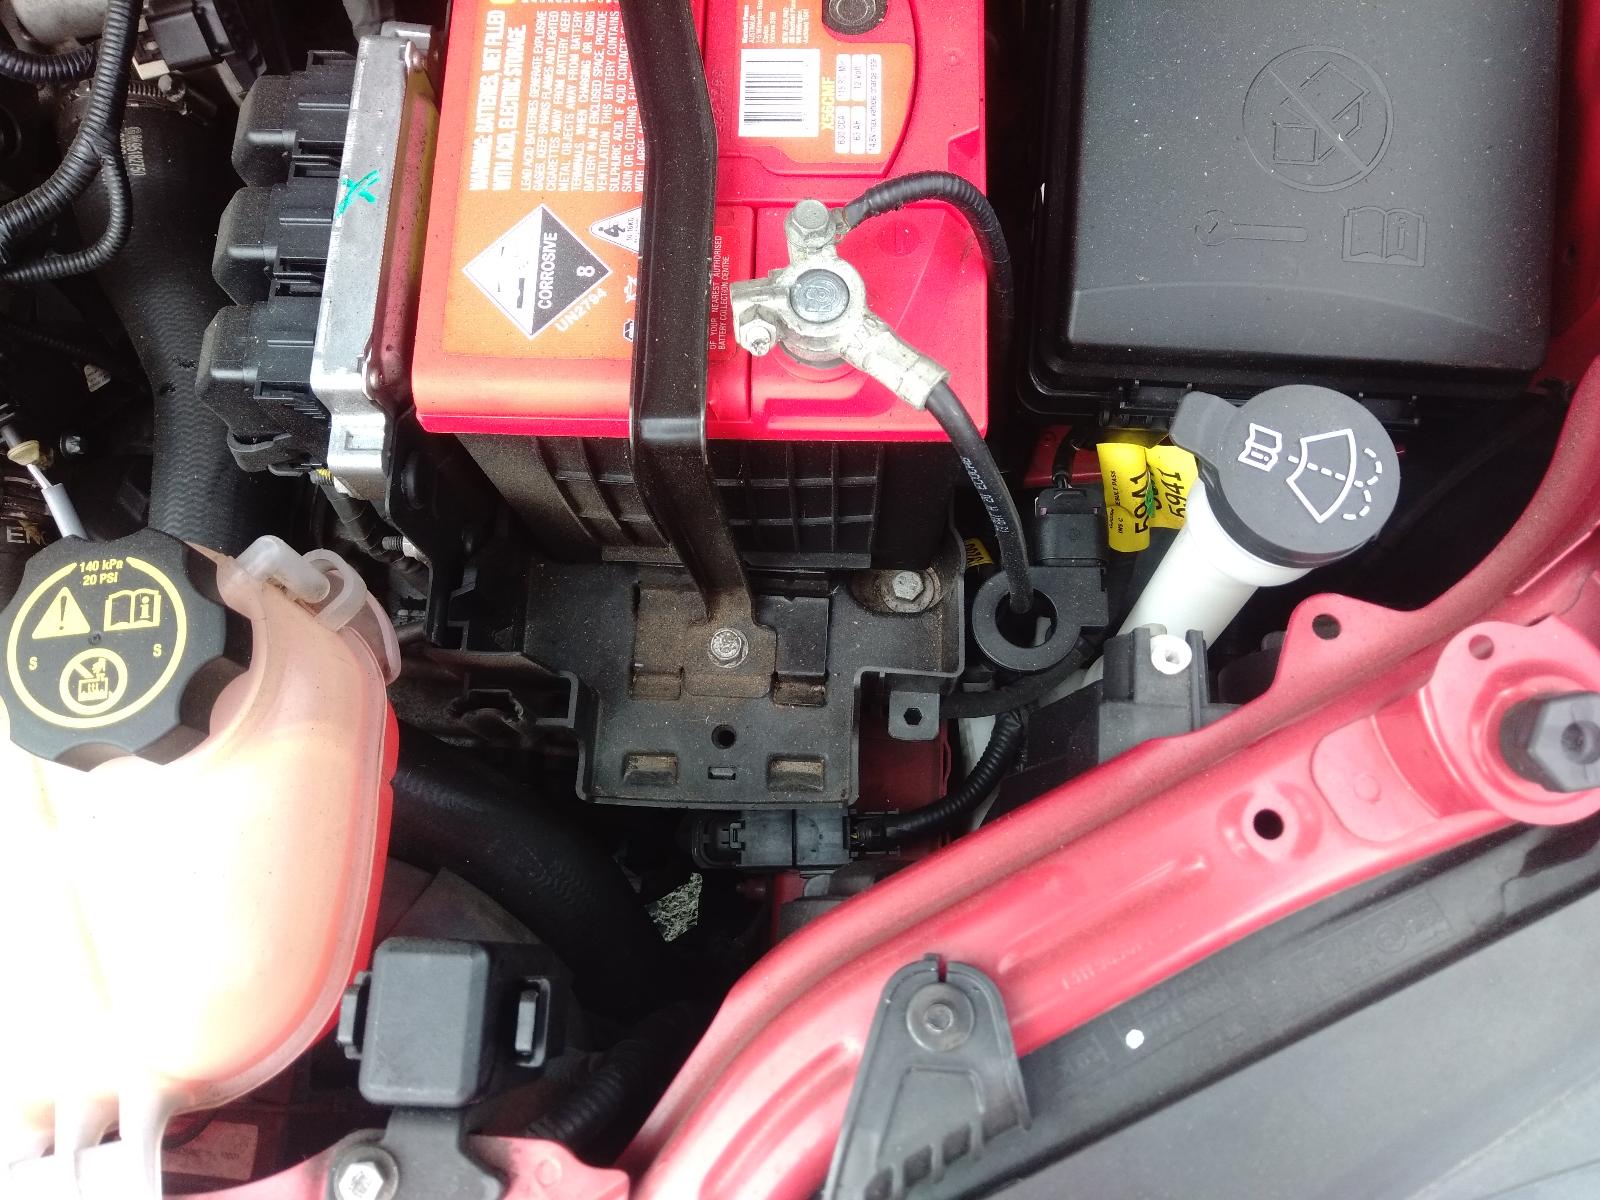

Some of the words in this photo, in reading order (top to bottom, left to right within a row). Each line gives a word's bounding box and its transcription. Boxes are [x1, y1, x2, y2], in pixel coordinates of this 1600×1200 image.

[532, 10, 548, 54] EXPLOSIVE
[546, 10, 560, 46] LIGHTED
[560, 10, 571, 32] KEEP
[570, 10, 583, 49] BATTERY
[583, 11, 596, 35] USING
[596, 11, 608, 46] PROVIDE
[607, 11, 620, 56] CONTAINS
[544, 48, 556, 65] AND
[582, 42, 592, 54] OR
[528, 56, 542, 98] GENERATE
[568, 54, 580, 80] FROM
[604, 60, 616, 100] BATTERY
[853, 66, 861, 78] Volt
[541, 67, 554, 100] FLAMES
[553, 80, 566, 104] FROM
[578, 60, 592, 102] CHARGING
[497, 78, 521, 129] ELECTRIC
[566, 84, 577, 110] AWAY
[590, 80, 602, 124] ENCLOSED
[524, 100, 538, 144] BATTERIES
[538, 101, 551, 135] SPARKS
[550, 109, 562, 134] AWAY
[576, 110, 588, 134] WHEN
[601, 104, 612, 124] THIS
[562, 114, 575, 156] OBJECTS
[586, 142, 596, 150] IN
[588, 128, 598, 140] AN
[609, 144, 622, 192] SULPHURIC
[616, 84, 627, 104] ACID
[522, 146, 534, 168] ACID
[536, 137, 547, 159] KEEP
[545, 137, 561, 191] CIGARETTES
[584, 156, 596, 192] BATTERY
[624, 156, 634, 168] OR
[492, 162, 512, 190] WITH
[521, 168, 532, 190] LEAD
[558, 162, 570, 191] METAL
[622, 170, 633, 192] SKIN
[635, 170, 645, 192] WITH
[713, 236, 722, 277] AUTHORISED
[538, 232, 557, 309] CORROSIVE
[576, 265, 595, 278] 8
[554, 287, 607, 332] UN2794
[712, 282, 720, 312] NEAREST
[720, 282, 729, 320] COLLECTION
[710, 317, 718, 336] YOUR
[718, 322, 726, 350] BATTERY
[710, 340, 718, 350] OF
[80, 560, 99, 573] 140
[102, 558, 124, 570] kPa
[83, 574, 97, 586] 20
[99, 571, 119, 584] PSI
[152, 643, 162, 657] S
[28, 656, 38, 671] S
